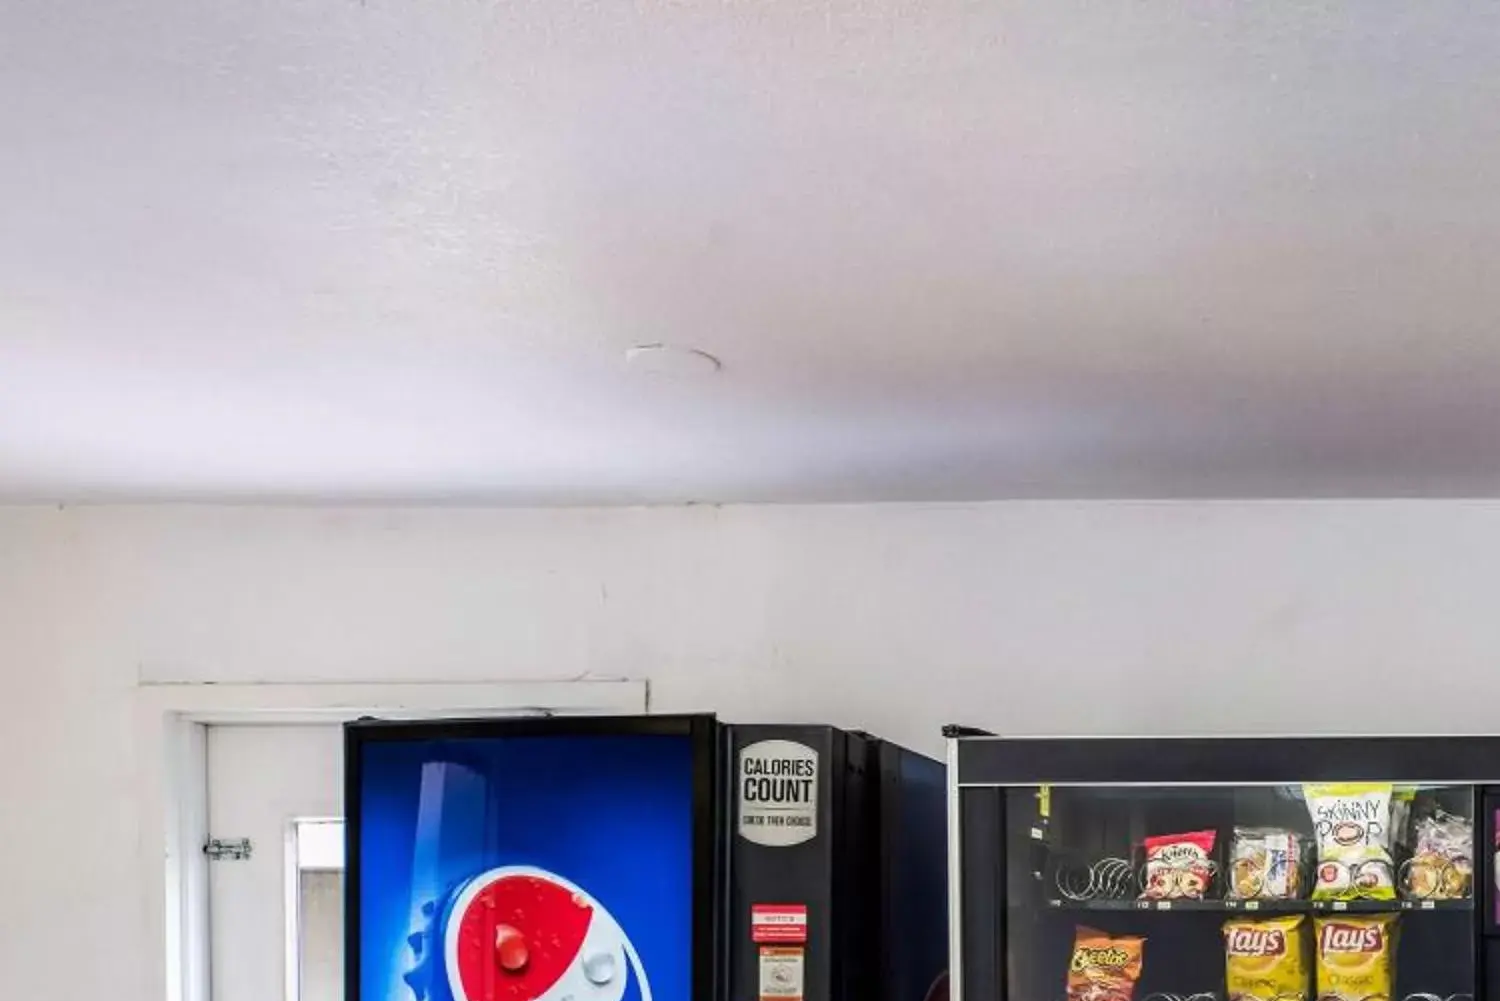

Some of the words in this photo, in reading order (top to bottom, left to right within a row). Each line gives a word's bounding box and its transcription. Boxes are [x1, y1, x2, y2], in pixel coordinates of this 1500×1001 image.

[743, 758, 815, 777] CALORIES
[743, 778, 813, 803] COUNT
[1316, 799, 1381, 820] SKINNY
[1315, 820, 1383, 847] POP
